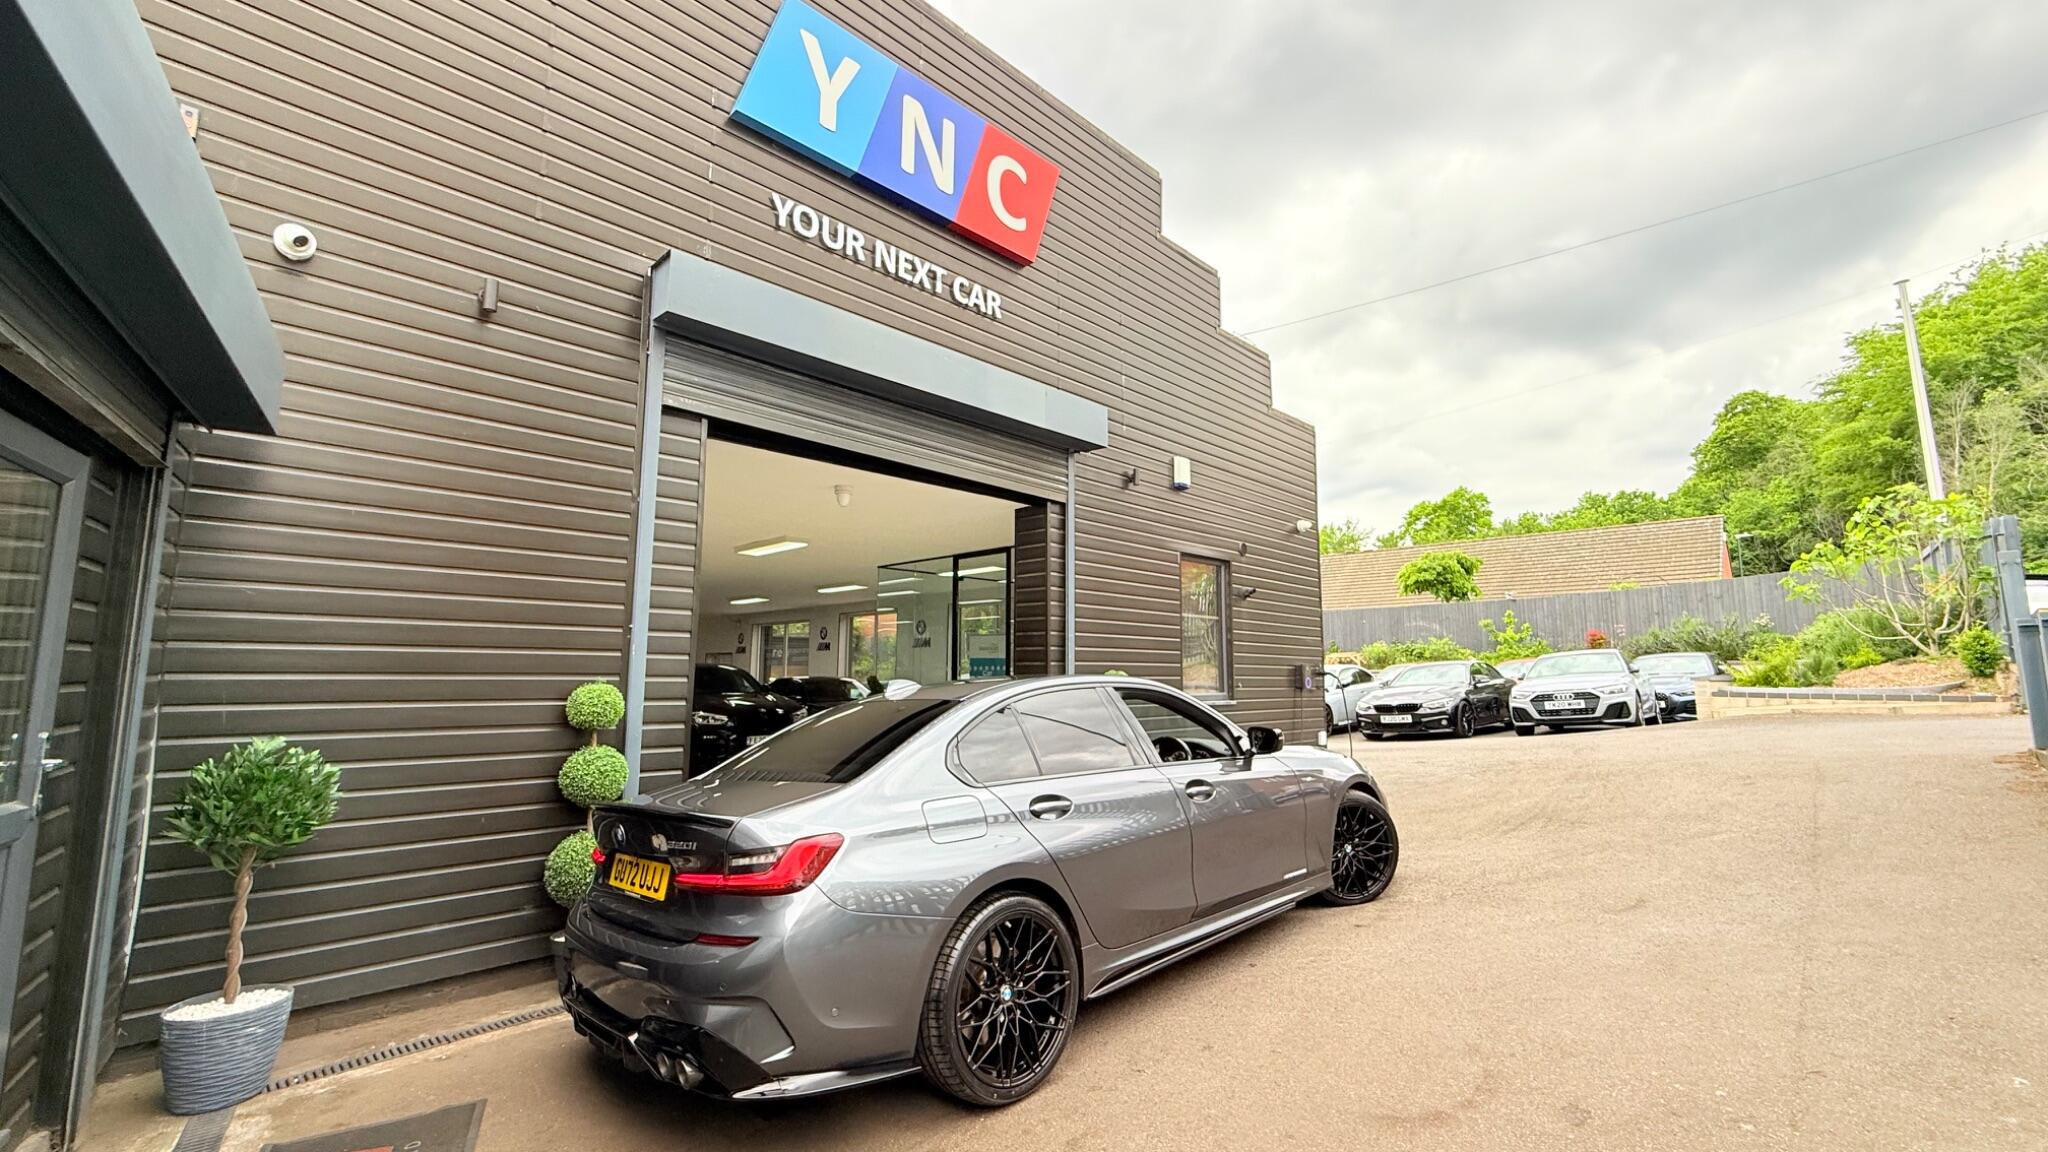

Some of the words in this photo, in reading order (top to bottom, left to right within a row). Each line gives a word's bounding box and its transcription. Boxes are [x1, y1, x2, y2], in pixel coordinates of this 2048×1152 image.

[771, 192, 865, 262] YOUR
[874, 240, 947, 294] NEXT
[952, 275, 1003, 319] CAR
[614, 857, 640, 887] GU72
[639, 863, 665, 893] UJJ
